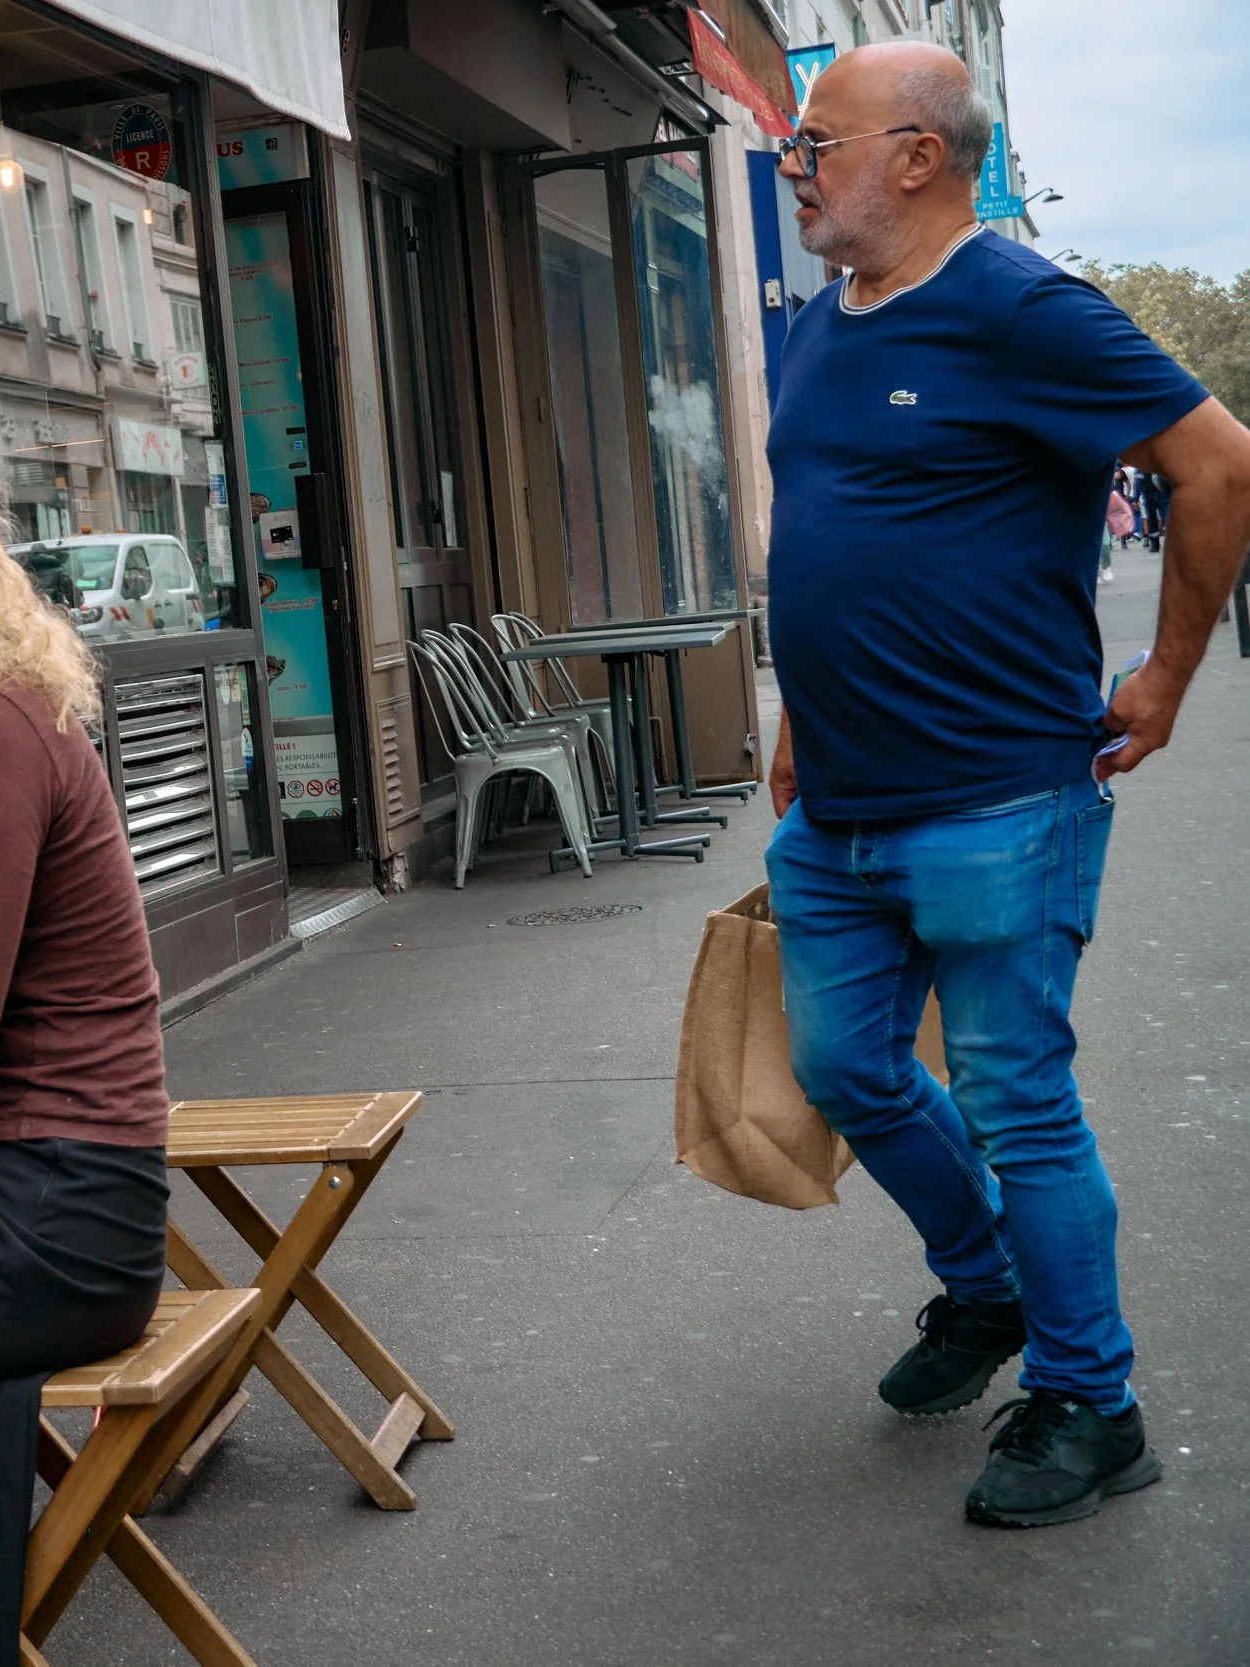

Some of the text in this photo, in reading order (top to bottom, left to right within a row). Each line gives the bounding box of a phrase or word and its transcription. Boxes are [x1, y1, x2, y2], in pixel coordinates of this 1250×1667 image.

[145, 108, 166, 132] PARIS
[126, 129, 155, 143] LICENCE
[134, 150, 152, 170] R
[982, 200, 1008, 209] PETIT
